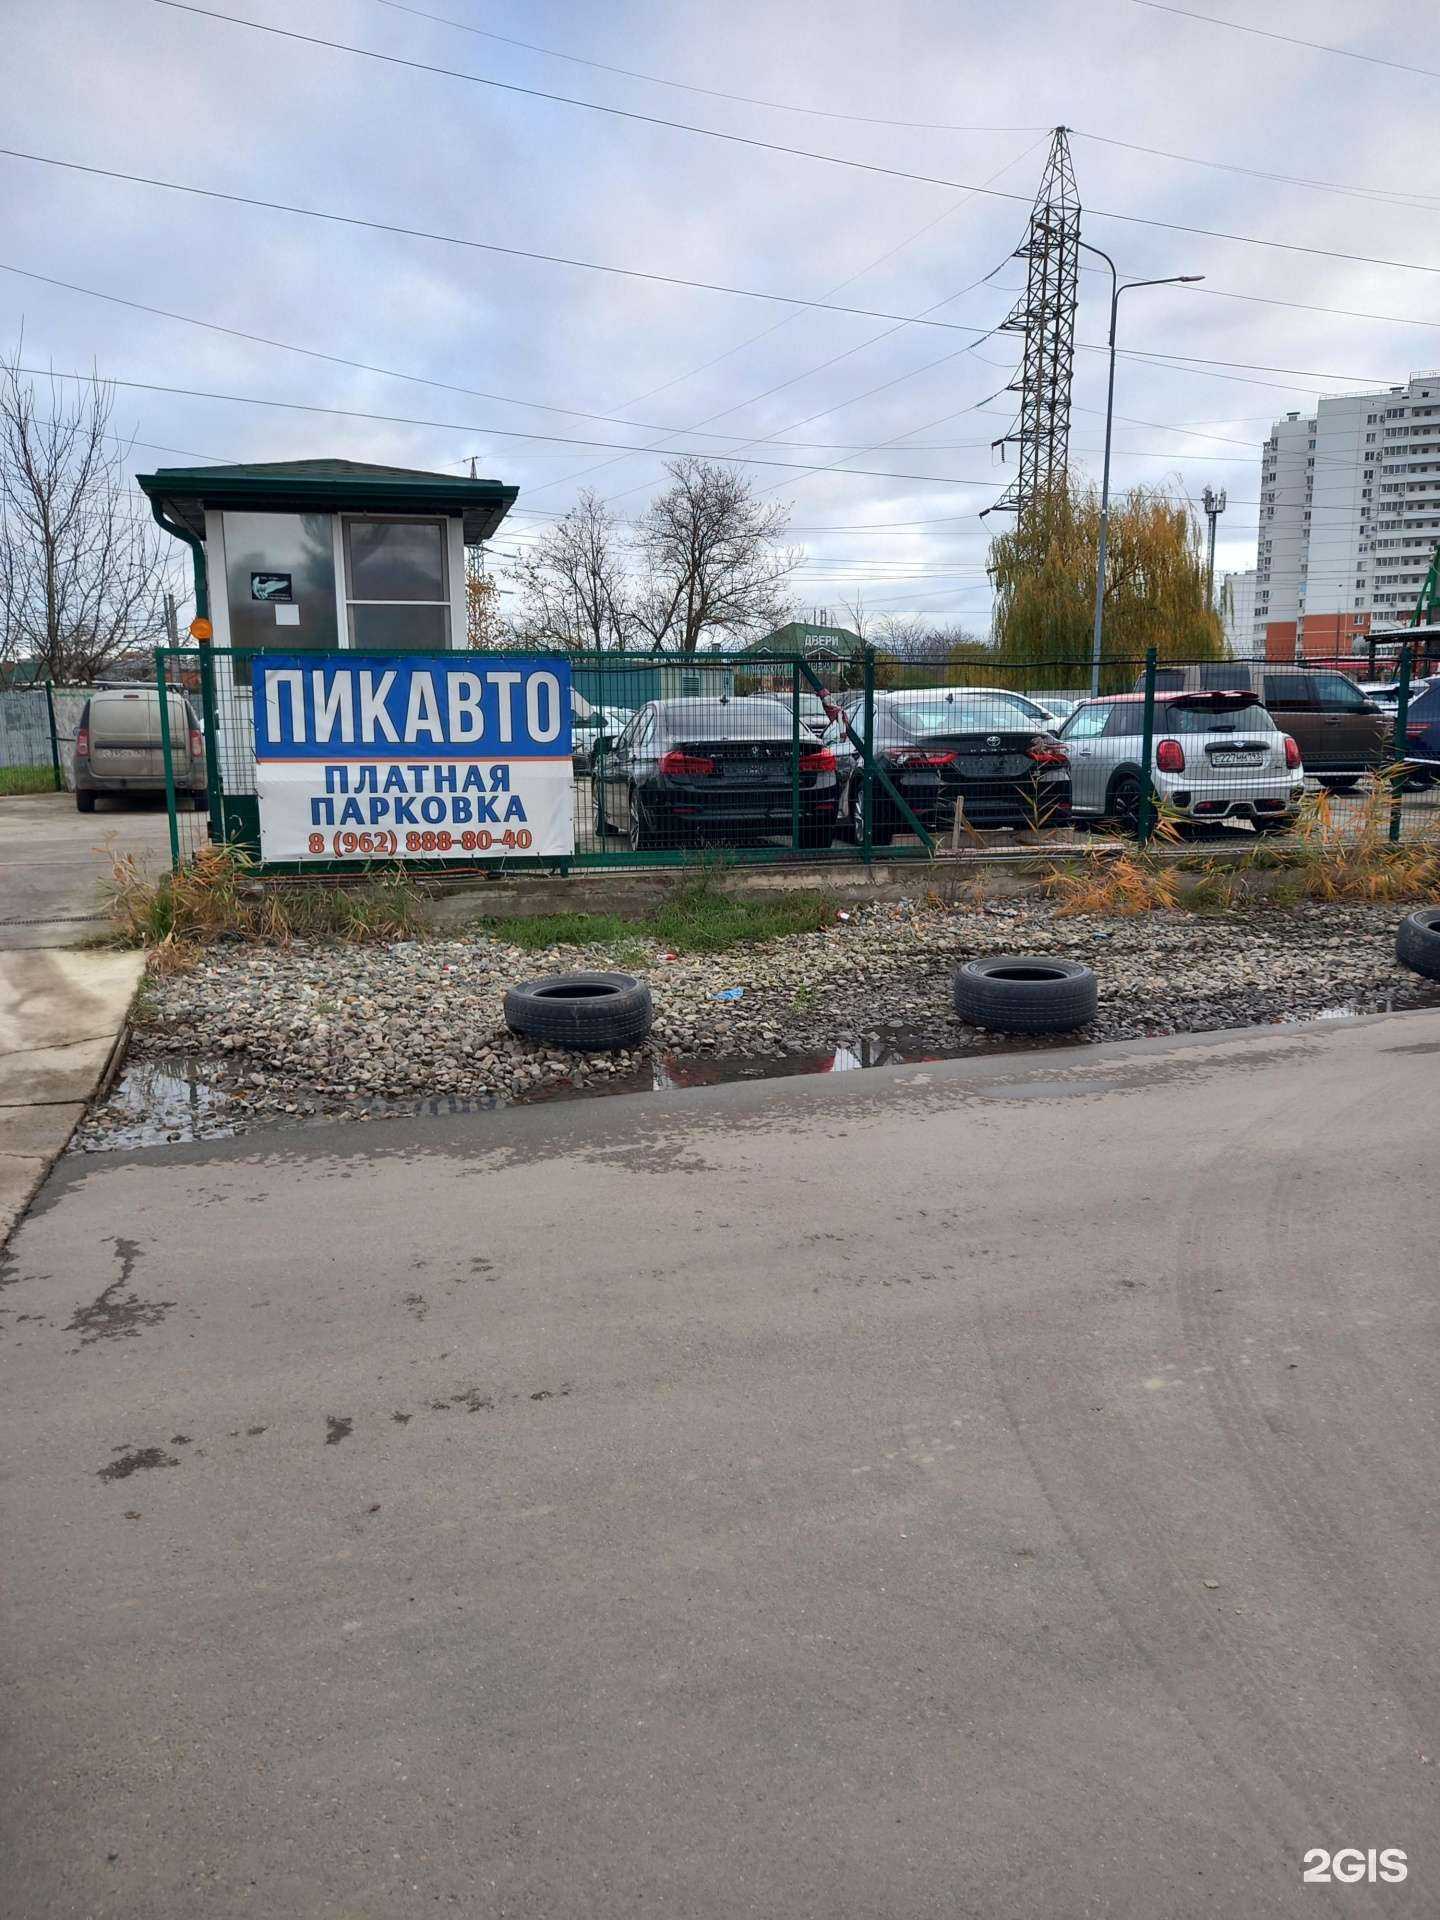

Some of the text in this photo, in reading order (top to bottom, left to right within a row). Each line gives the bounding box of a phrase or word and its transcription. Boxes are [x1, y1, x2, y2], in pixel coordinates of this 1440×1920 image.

[804, 634, 839, 647] ДВЕРИ
[264, 669, 561, 743] ПИКАВТО
[324, 765, 510, 794] ПЛАТНАЯ
[310, 795, 528, 825] ПАРКОВКА
[308, 828, 533, 857] 8 (962) 888-80-40
